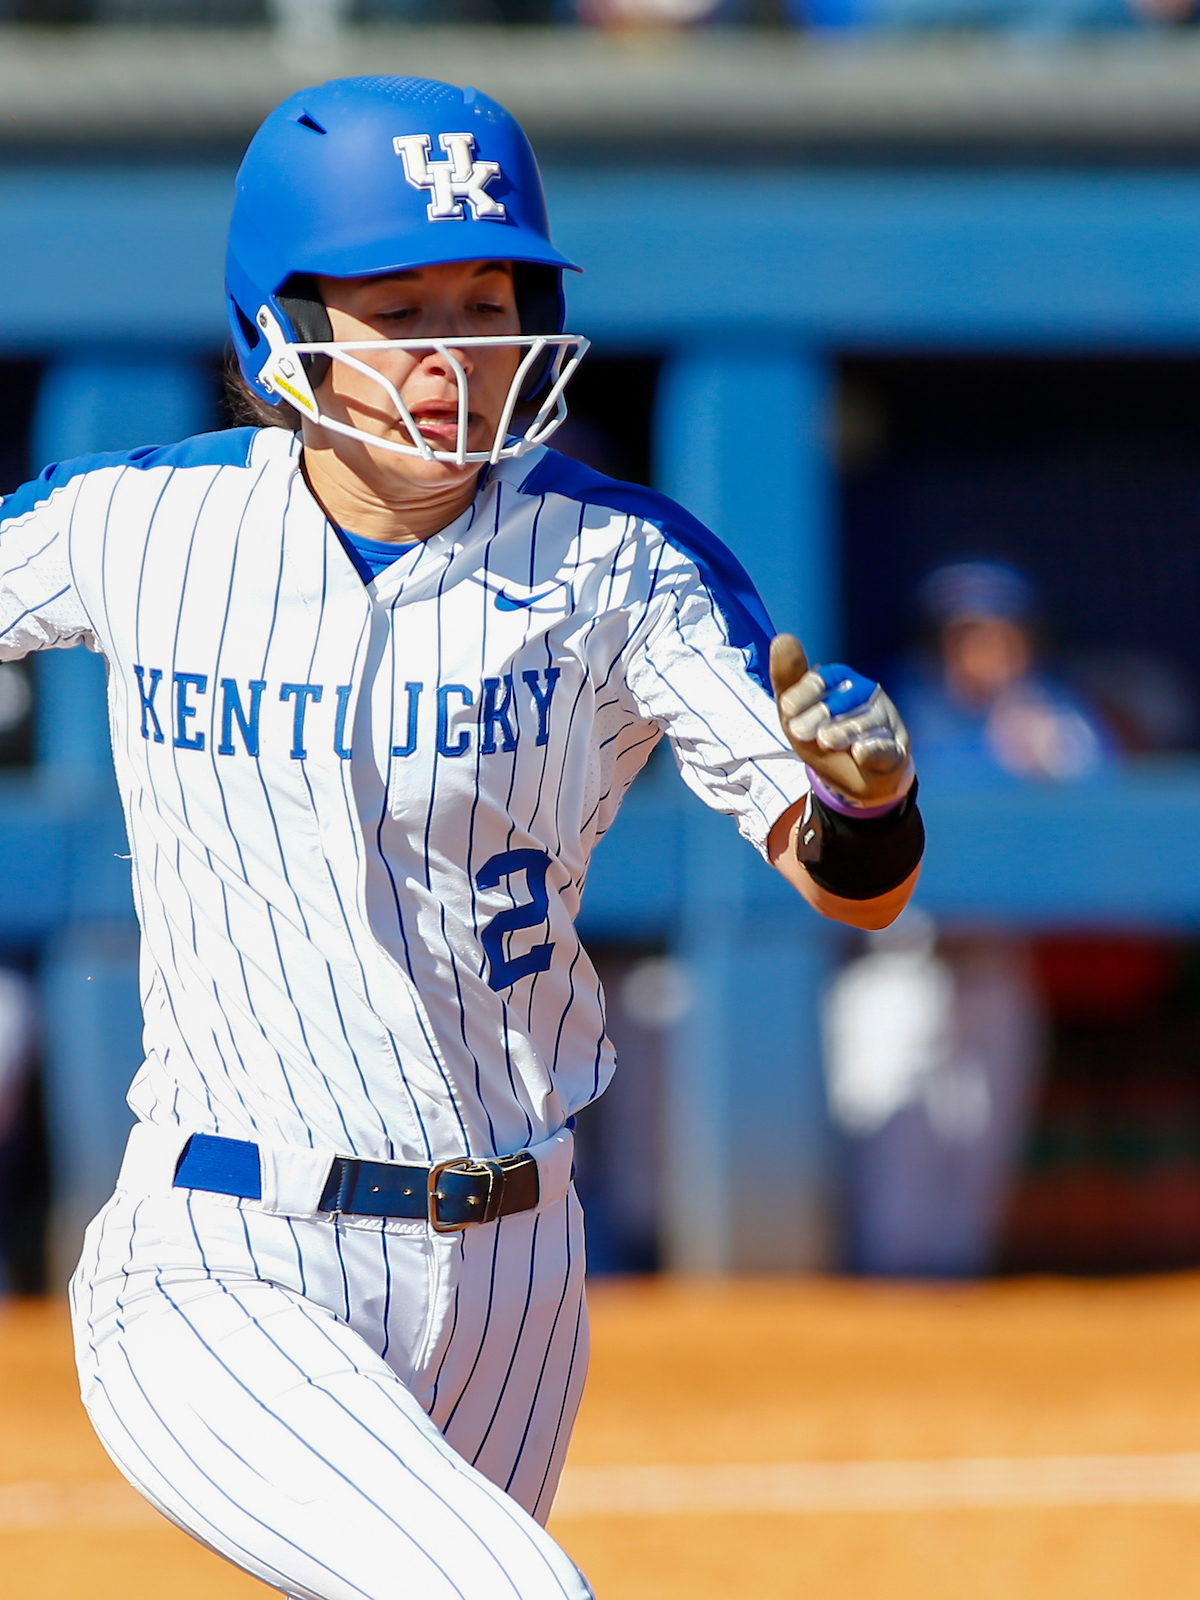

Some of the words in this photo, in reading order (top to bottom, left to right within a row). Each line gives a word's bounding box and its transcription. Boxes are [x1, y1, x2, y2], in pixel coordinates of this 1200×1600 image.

[393, 132, 506, 221] UK
[133, 663, 560, 760] KENTUCKY
[475, 848, 553, 992] 2
